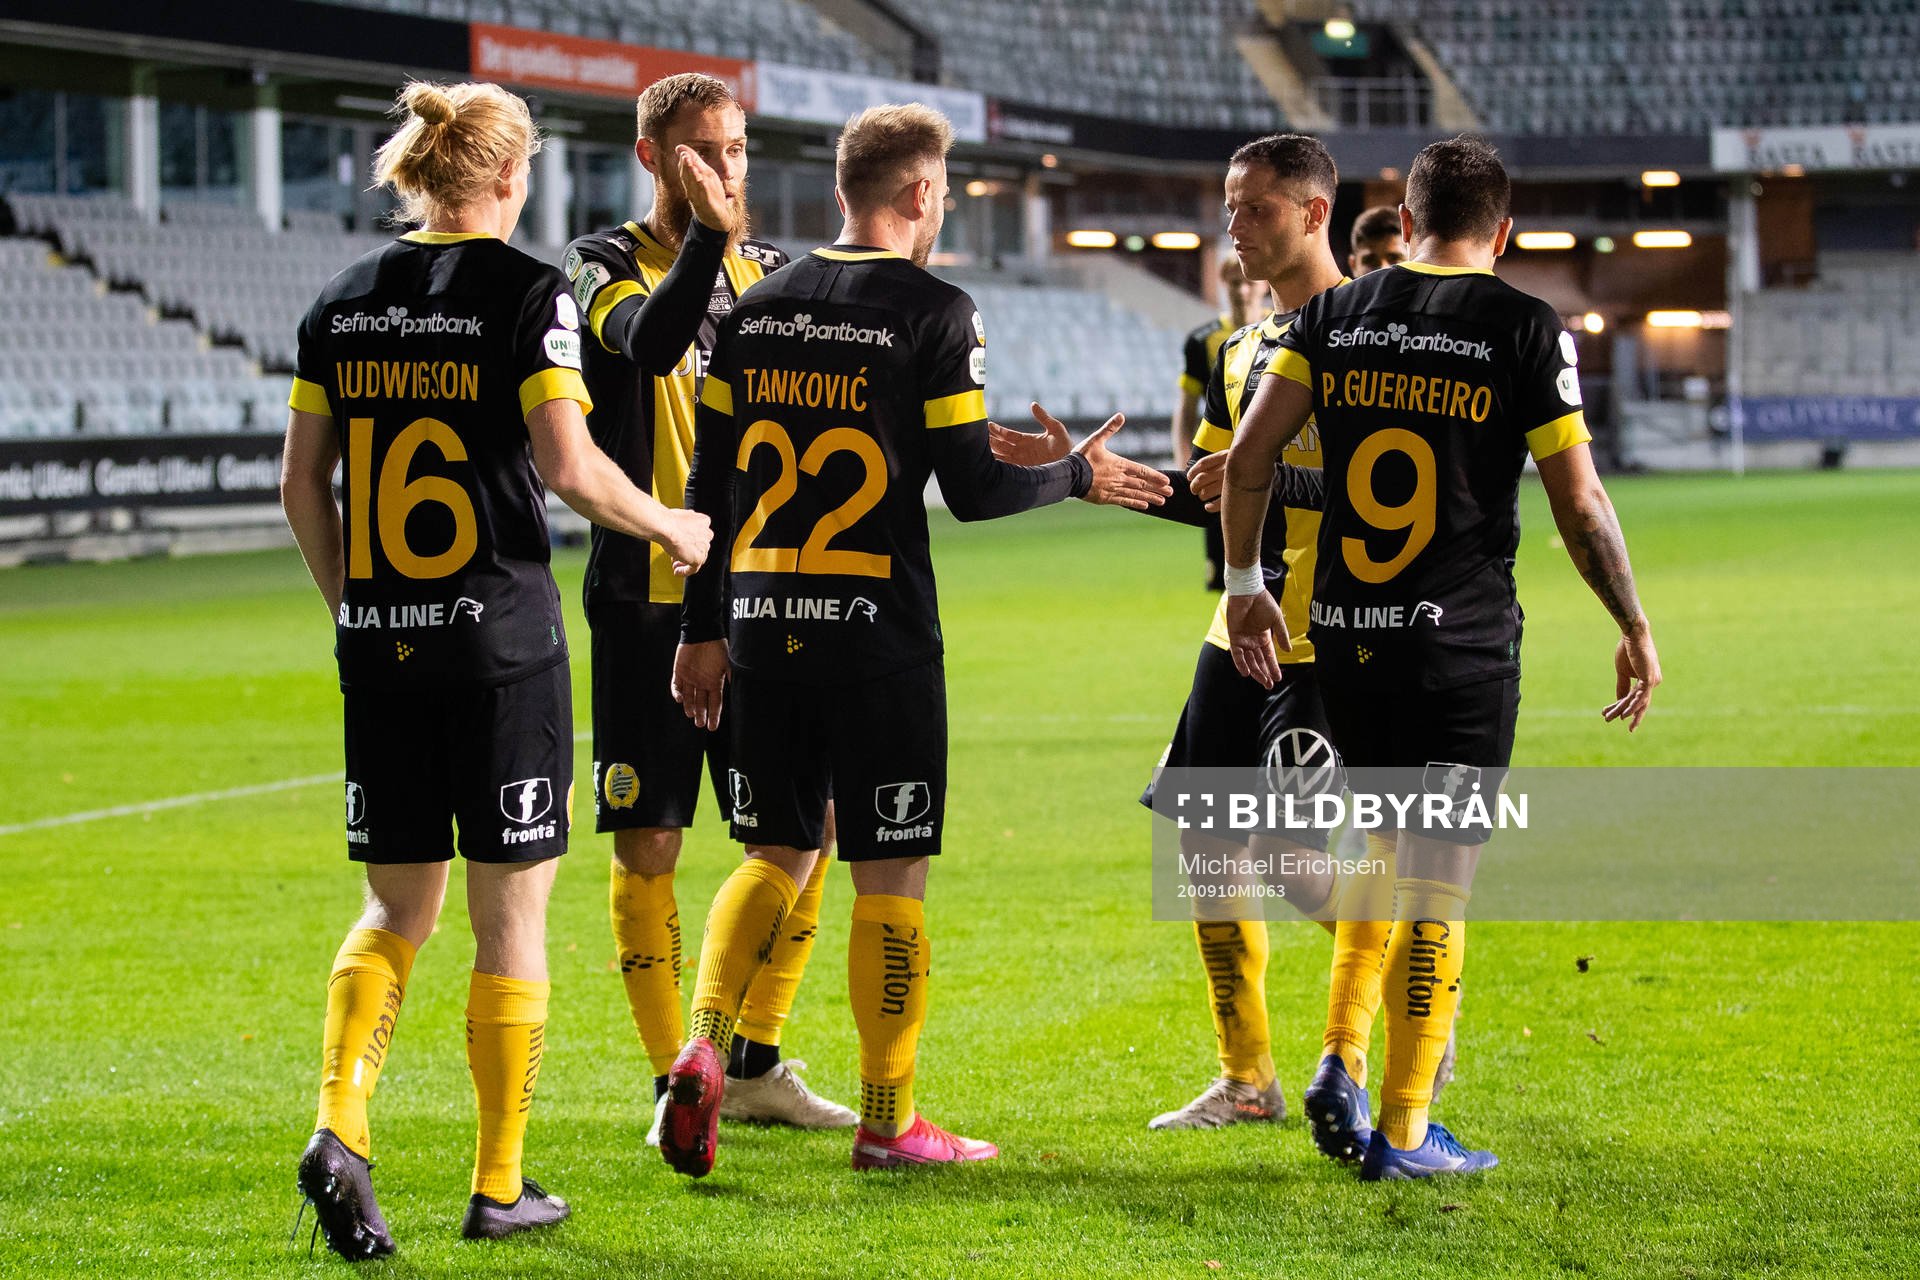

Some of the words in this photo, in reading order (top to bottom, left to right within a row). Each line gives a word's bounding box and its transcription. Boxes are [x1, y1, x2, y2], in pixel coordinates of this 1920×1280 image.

[331, 312, 390, 334] Sefina
[400, 312, 484, 337] pantbank
[738, 316, 796, 336] Sefina
[803, 322, 895, 347] pantbank
[1327, 327, 1390, 347] Sefina
[1399, 332, 1493, 362] pantbank
[743, 366, 869, 412] TANKOVIĆ
[1322, 370, 1492, 423] P.GUERREIRO
[349, 417, 478, 579] 16
[730, 419, 891, 579] 22
[1342, 427, 1437, 584] 9
[389, 604, 444, 628] LINE
[733, 598, 777, 620] SILJA
[785, 598, 840, 621] LINE
[1310, 600, 1346, 628] SILJA
[1353, 606, 1404, 629] LINE
[502, 824, 556, 845] fronta
[876, 824, 933, 842] fronta
[1199, 921, 1247, 1017] Clinton
[1407, 917, 1450, 1018] Clinton
